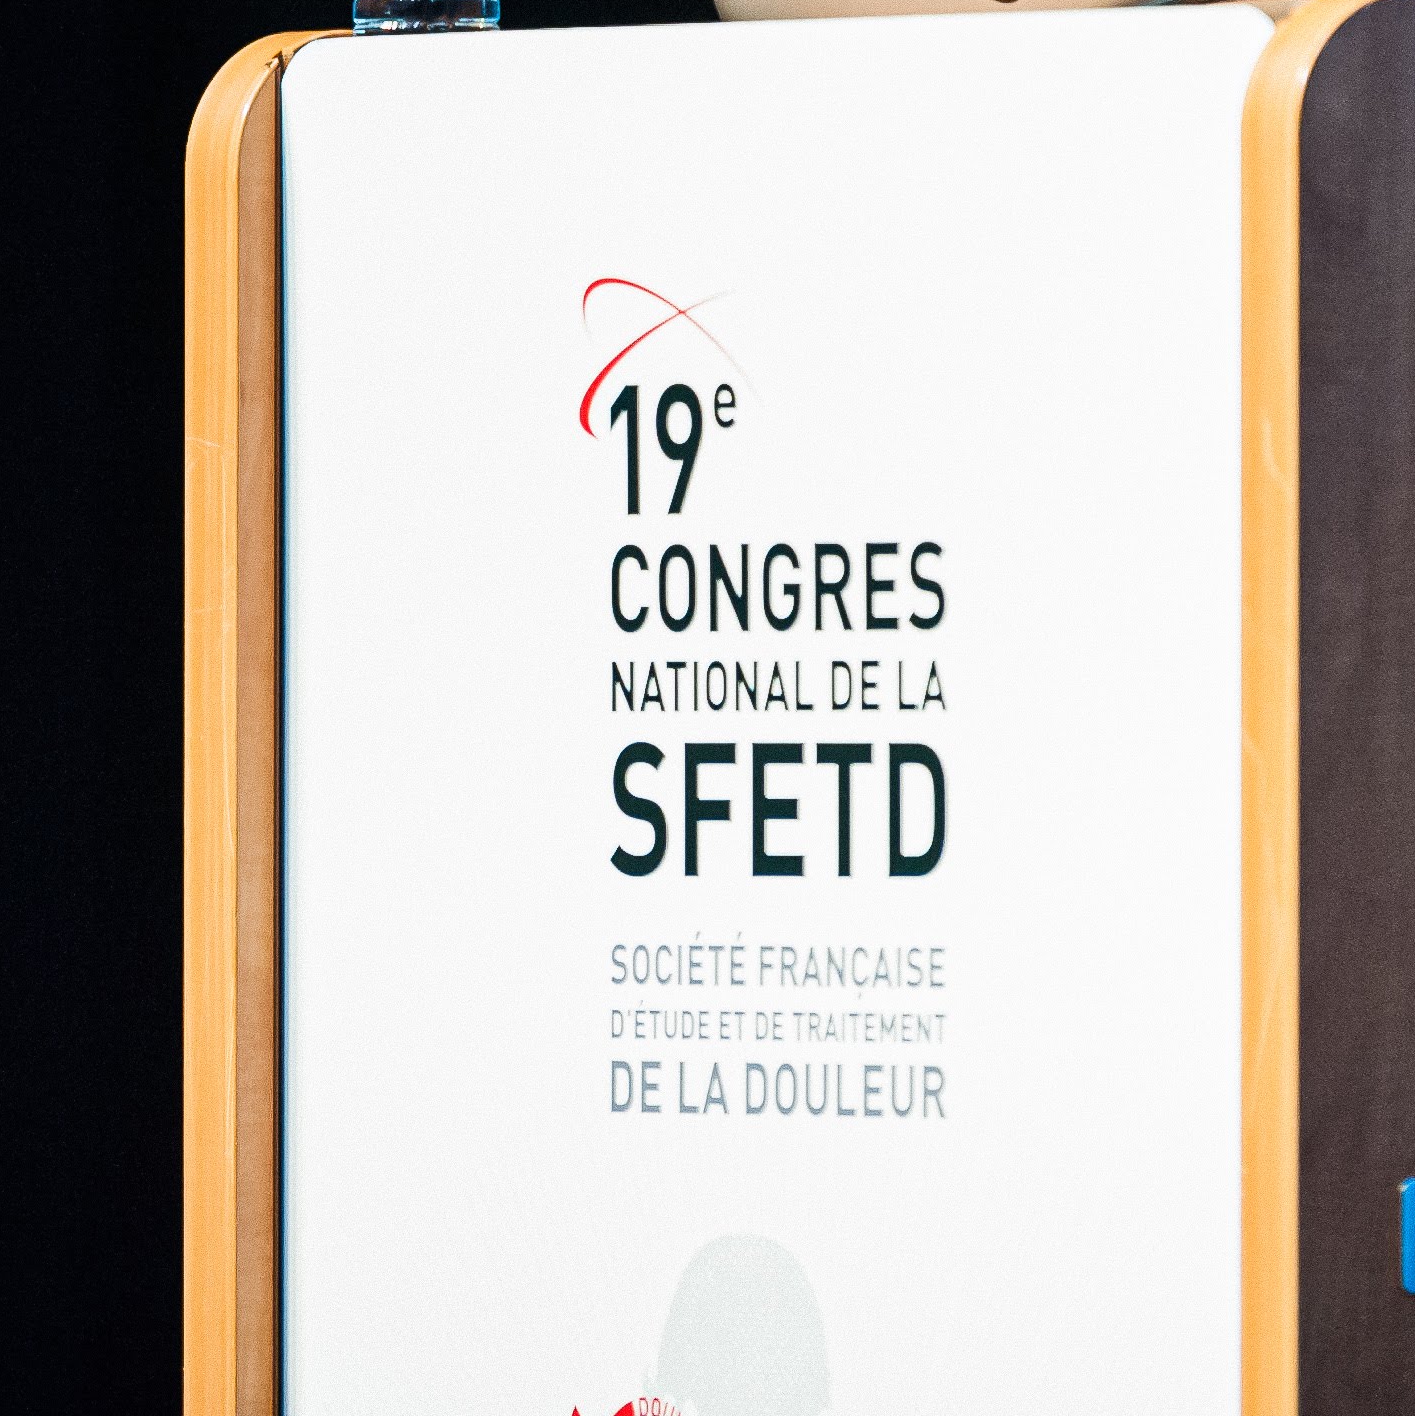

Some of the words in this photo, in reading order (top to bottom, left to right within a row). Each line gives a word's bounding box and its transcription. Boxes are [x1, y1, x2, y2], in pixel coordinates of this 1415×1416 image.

[610, 383, 736, 516] 19e
[610, 540, 946, 634] CONGRES
[611, 660, 814, 713] NATIONAL
[831, 660, 880, 712] DE
[897, 660, 947, 712] LA
[610, 740, 947, 878] SFETD
[611, 931, 746, 986] SOCIÉTÉ
[759, 945, 946, 1000] FRANÇAISE
[611, 1000, 710, 1041] D'ÉTUDE
[719, 1011, 746, 1042] ET
[755, 1011, 783, 1042] DE
[793, 1012, 947, 1044] TRAITEMENT
[611, 1059, 662, 1114] DE
[679, 1060, 730, 1115] LA
[746, 1062, 947, 1120] DOULEUR
